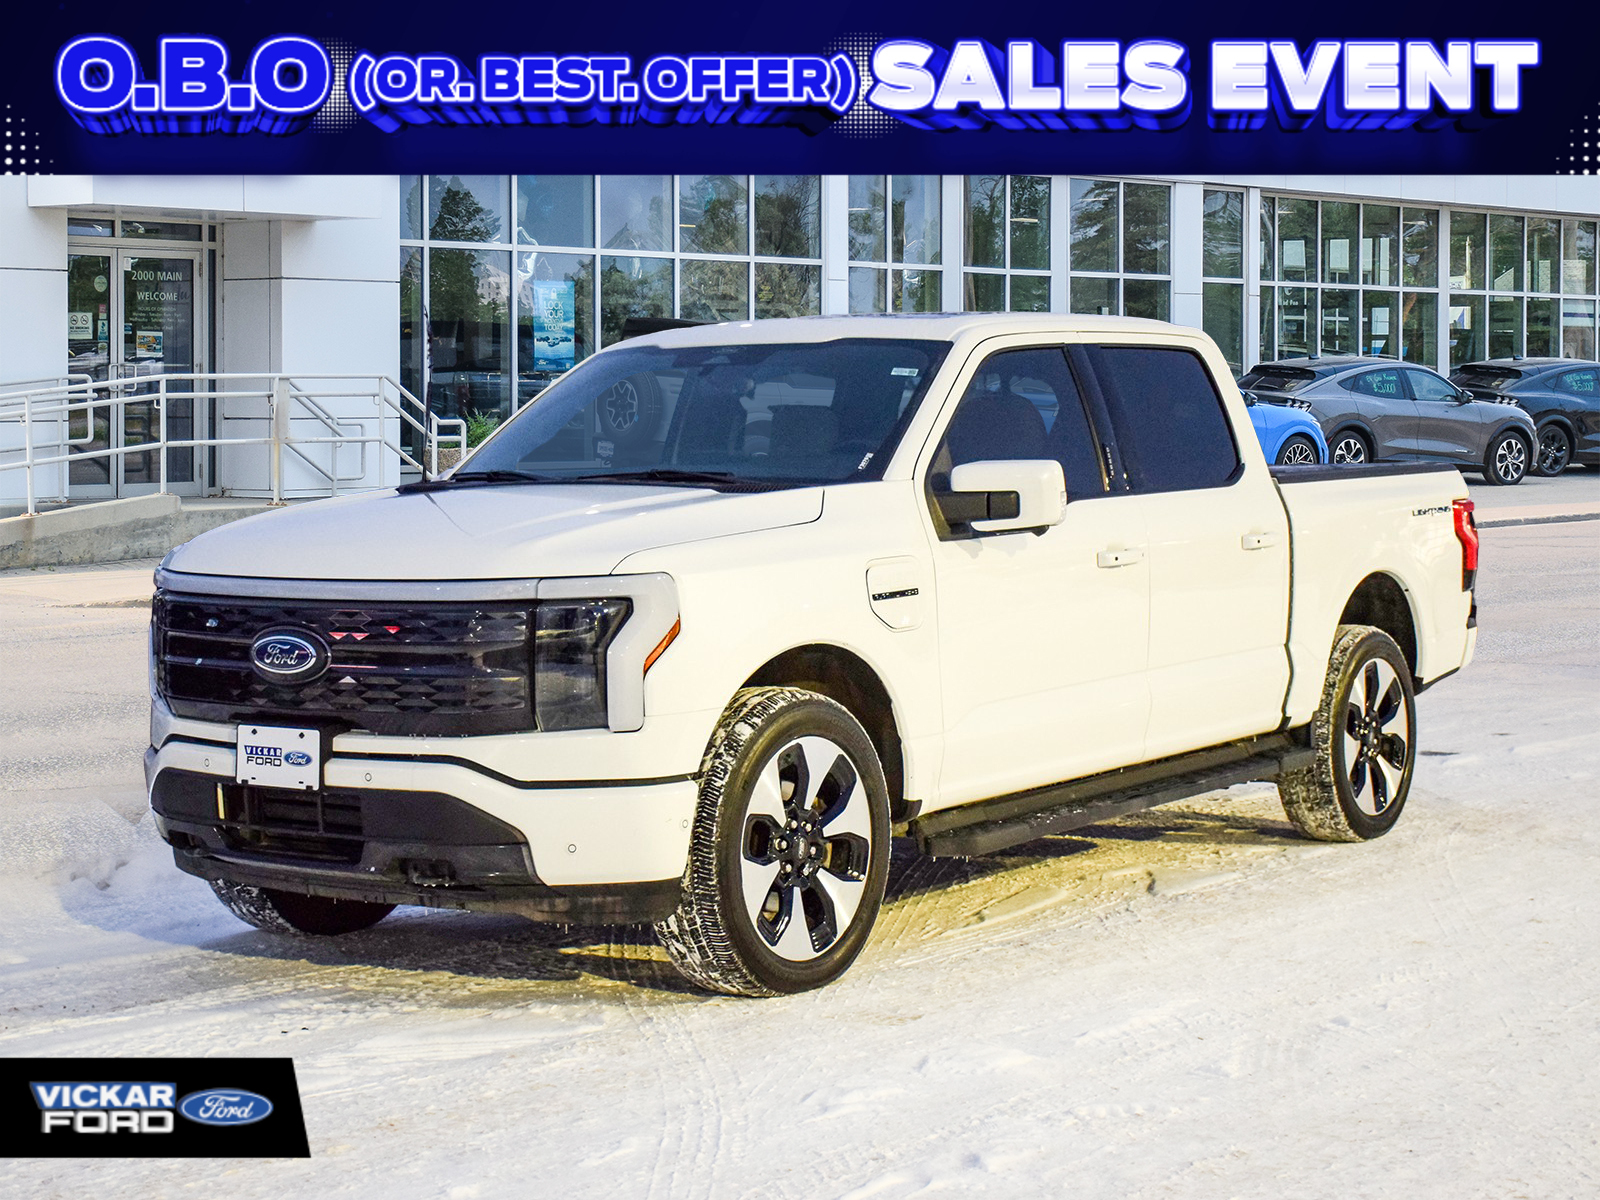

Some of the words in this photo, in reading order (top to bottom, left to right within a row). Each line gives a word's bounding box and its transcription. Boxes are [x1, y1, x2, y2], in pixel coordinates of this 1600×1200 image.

[131, 270, 155, 281] 2000
[157, 271, 183, 281] MAIN
[136, 291, 178, 301] WELCOME
[543, 309, 564, 318] YOUR
[264, 643, 299, 666] Ford
[245, 745, 282, 757] VICKAR
[246, 756, 282, 767] FORD
[287, 752, 307, 765] Ford
